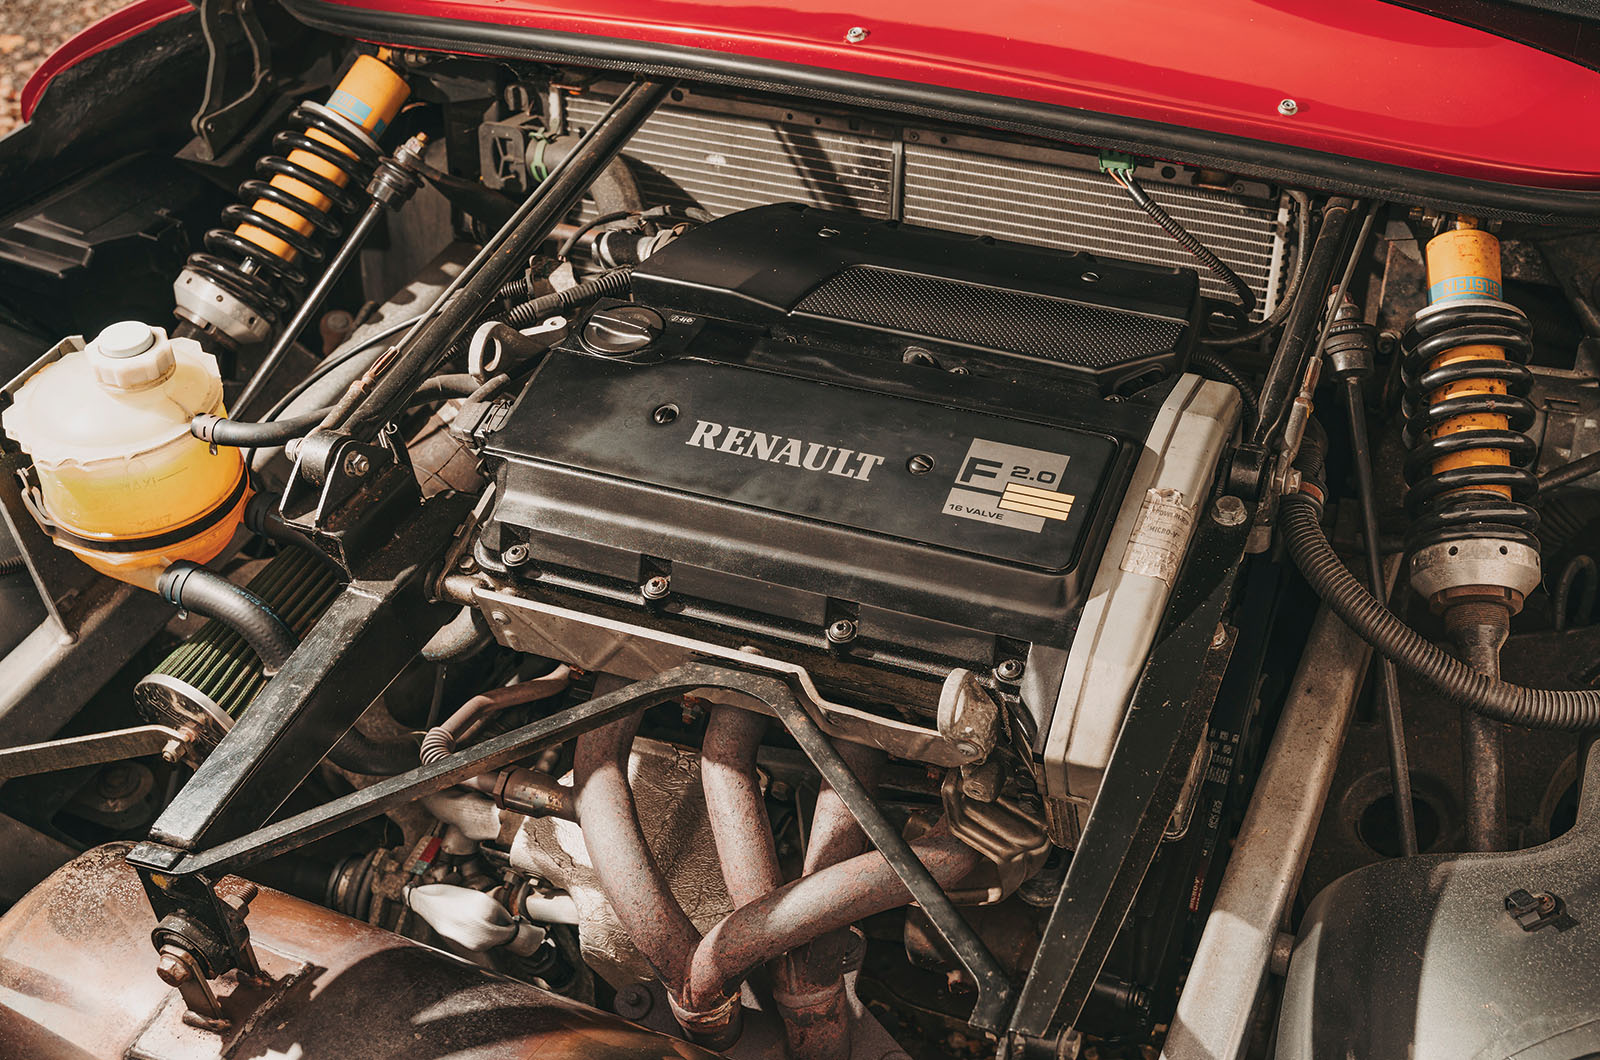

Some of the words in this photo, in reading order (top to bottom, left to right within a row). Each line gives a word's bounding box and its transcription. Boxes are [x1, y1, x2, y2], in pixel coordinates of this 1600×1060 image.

[1443, 278, 1499, 296] BILSTEIN
[685, 420, 885, 482] RENAULT
[960, 457, 1004, 483] F
[1010, 466, 1057, 484] 2.0
[949, 504, 962, 512] 16
[966, 507, 1005, 521] VALVE
